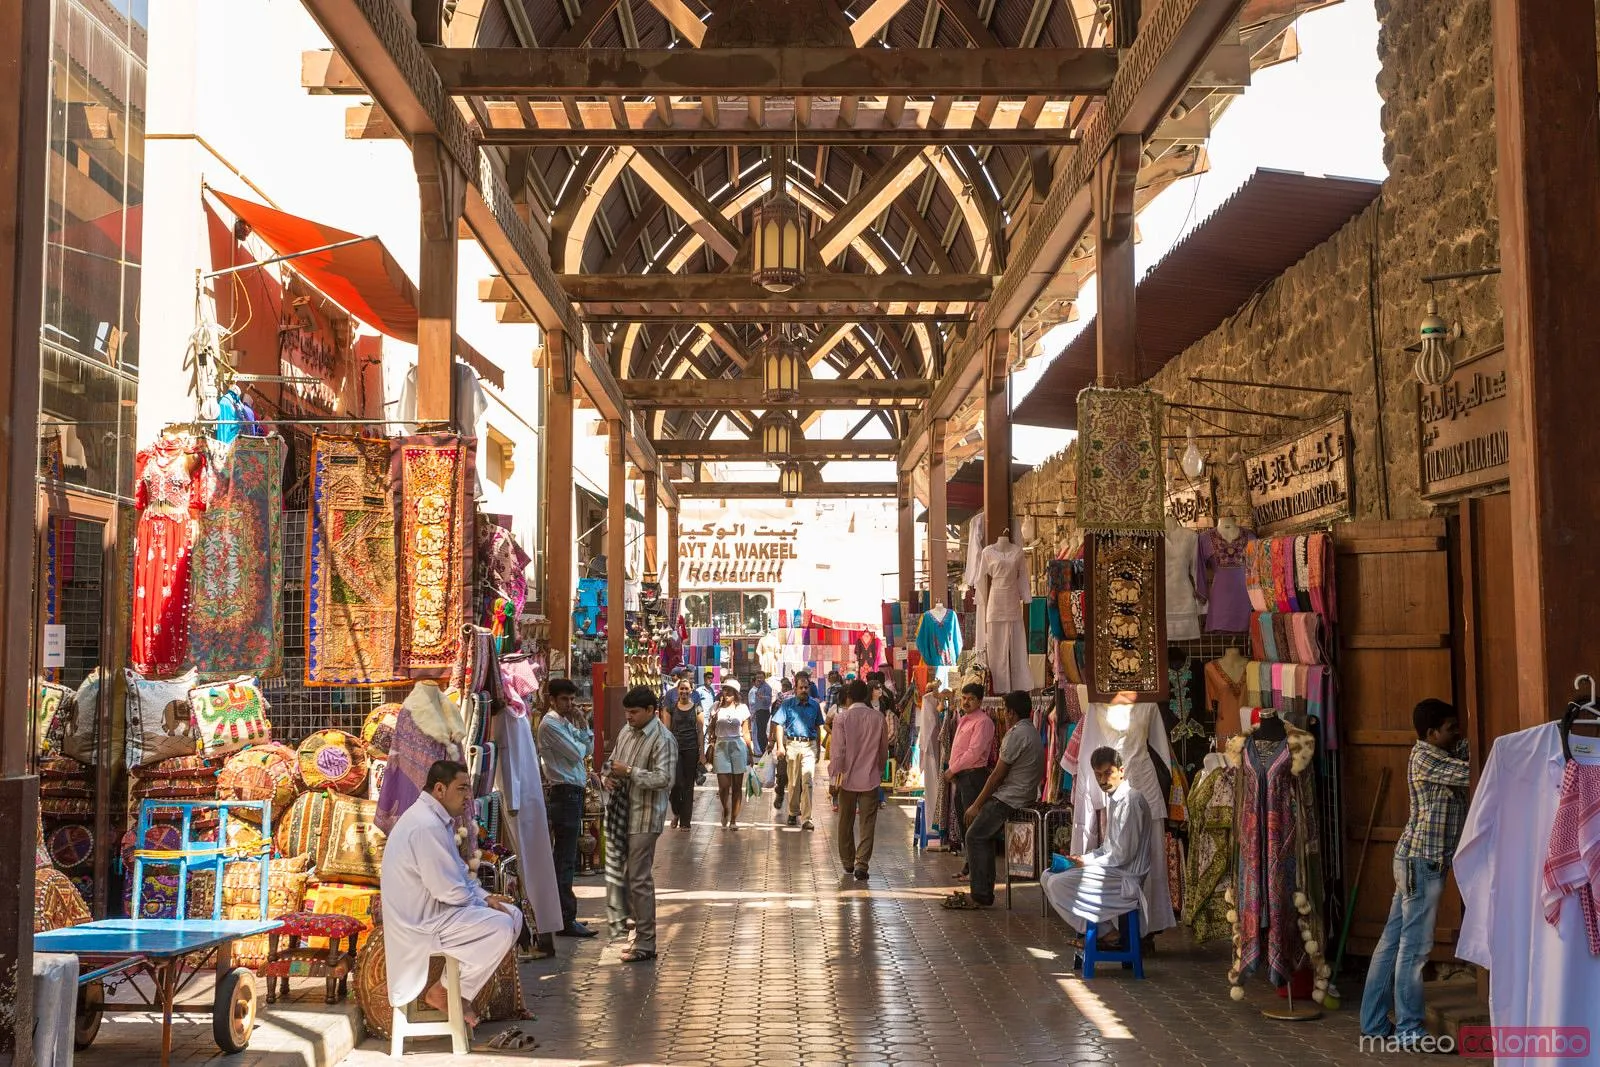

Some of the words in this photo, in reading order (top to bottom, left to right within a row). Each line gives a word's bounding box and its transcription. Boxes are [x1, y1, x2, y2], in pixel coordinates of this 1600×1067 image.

[1424, 446, 1462, 483] TULSIDAS
[1290, 486, 1322, 516] TRADING
[753, 525, 798, 541] بيت
[679, 542, 707, 559] AYT
[711, 542, 731, 559] AL
[734, 542, 798, 560] WAKEEL
[688, 566, 783, 583] Restaurant
